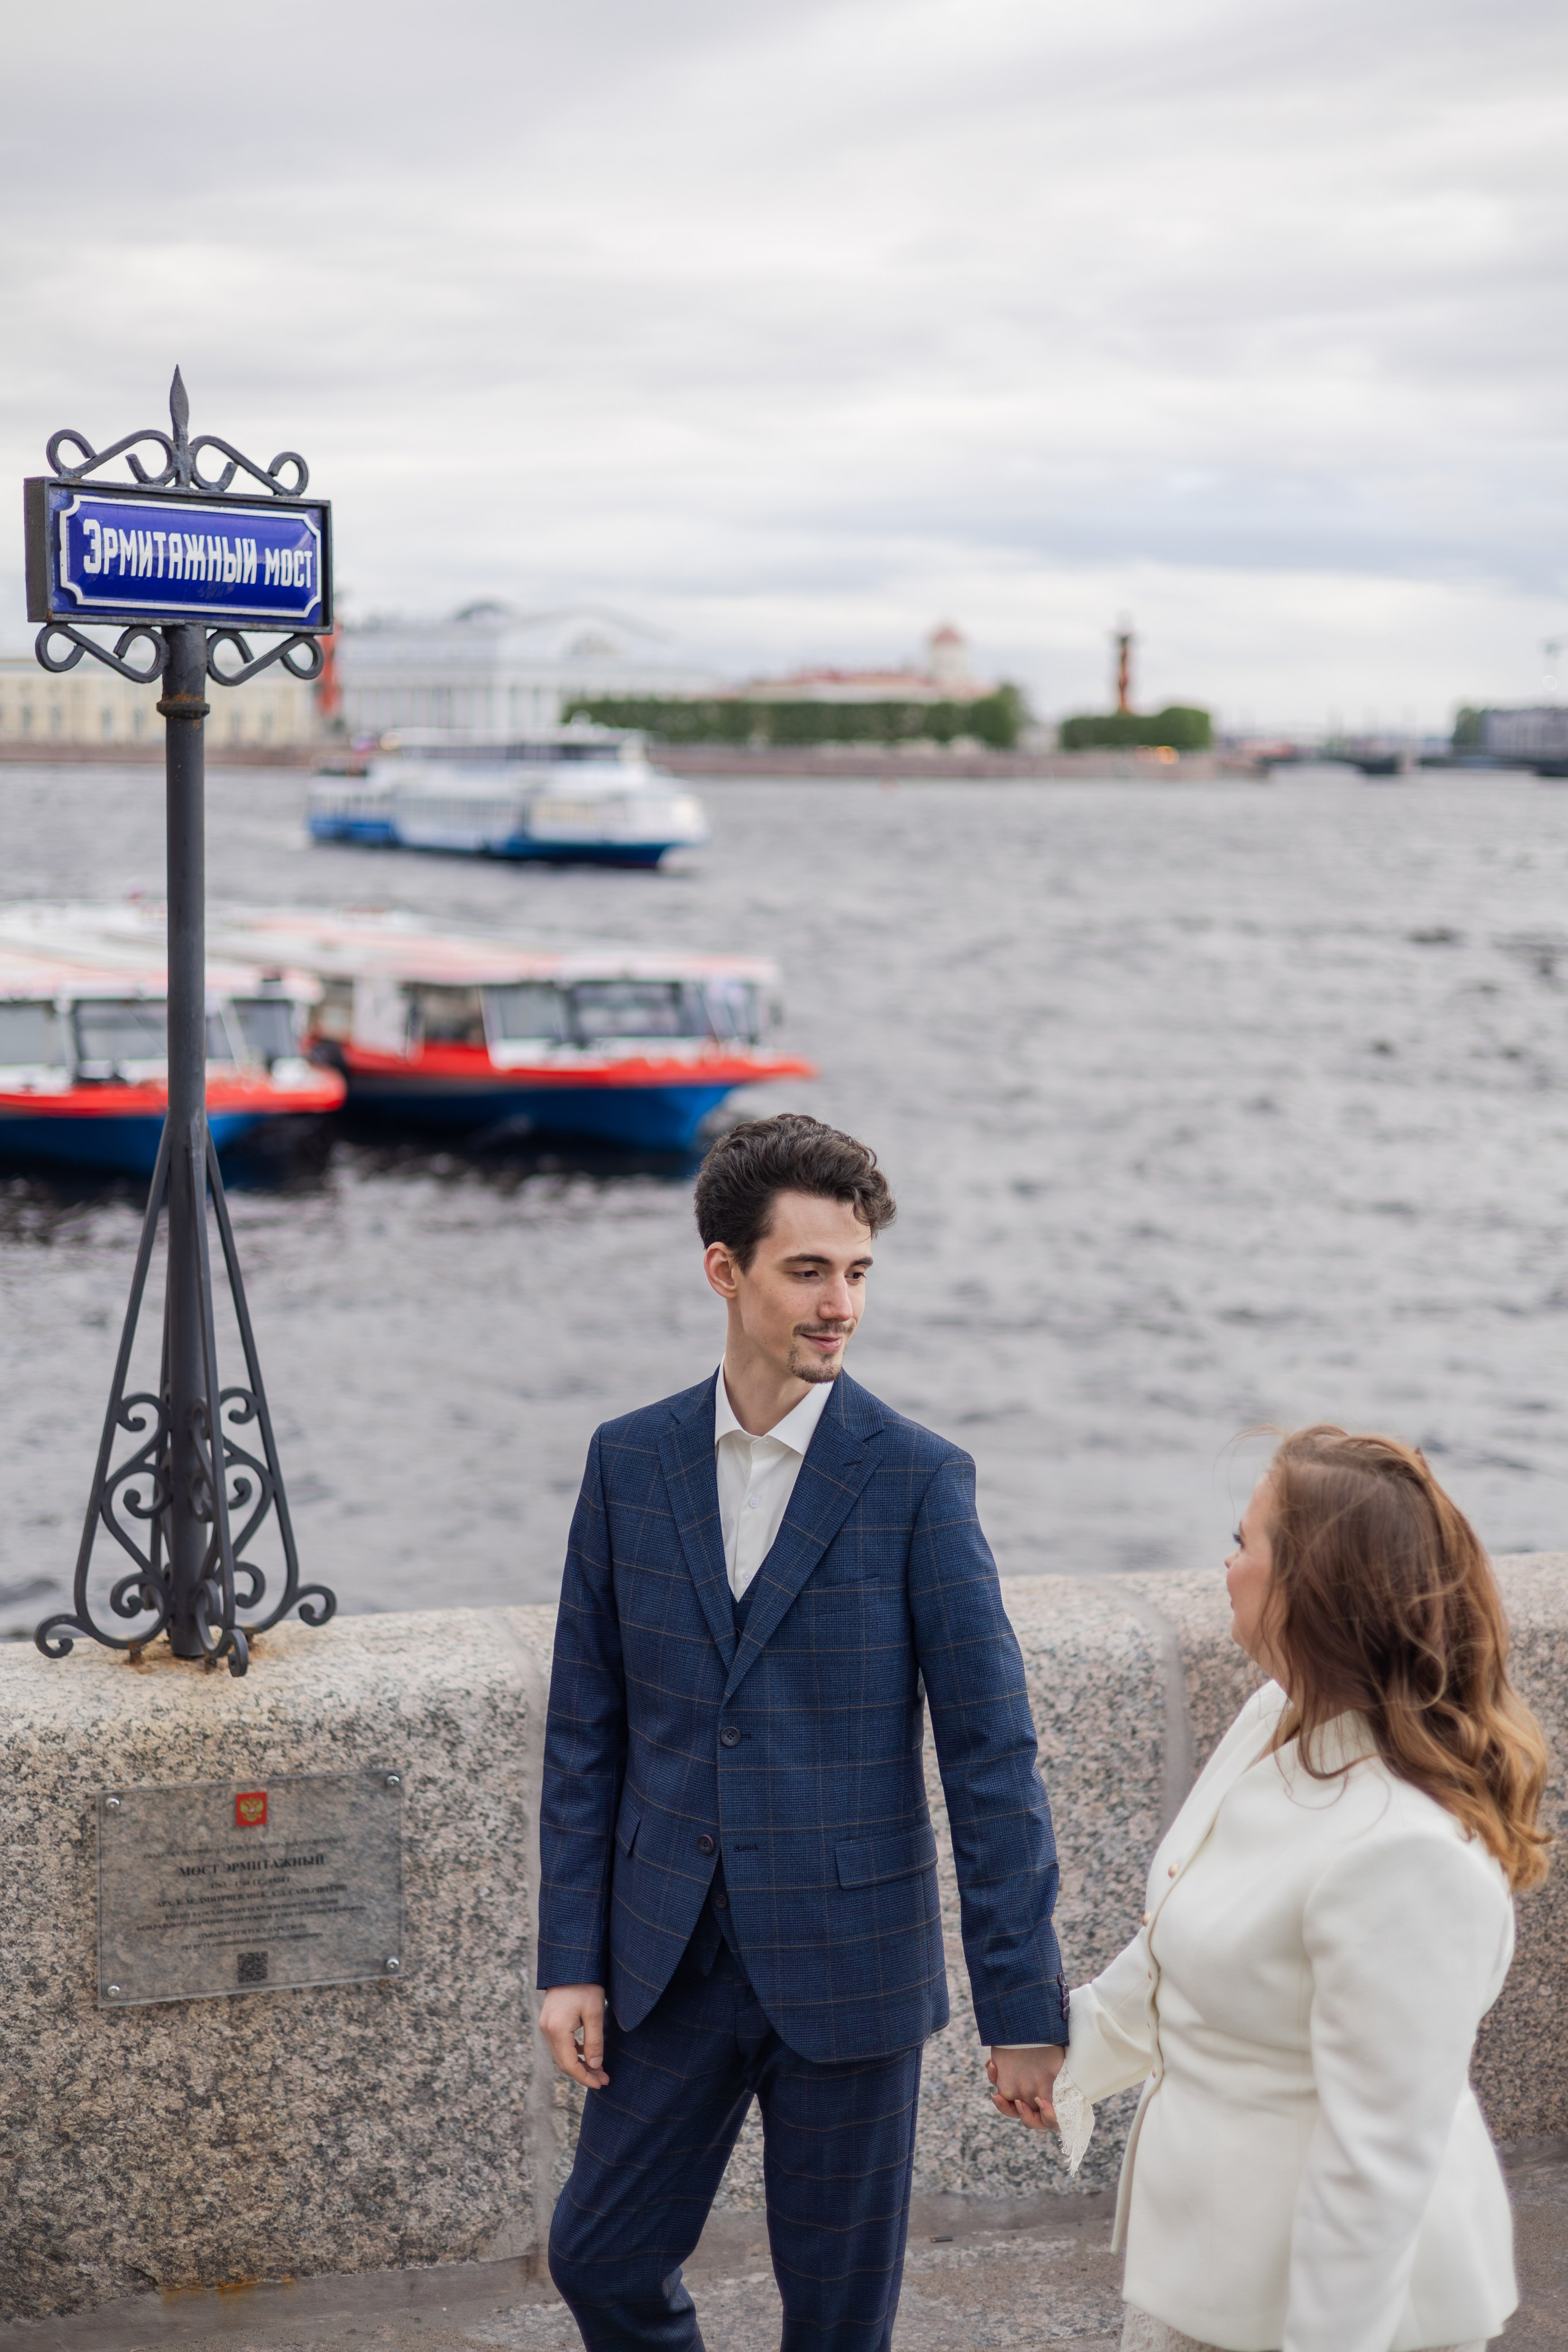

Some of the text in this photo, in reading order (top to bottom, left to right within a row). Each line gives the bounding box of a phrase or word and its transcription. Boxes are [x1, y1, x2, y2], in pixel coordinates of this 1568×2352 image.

[83, 519, 313, 589] ЭРМИТАЖНЫЙ МОСТ
[179, 1853, 325, 1877] МОСТ ЭРМИТАЖНЫЙ
